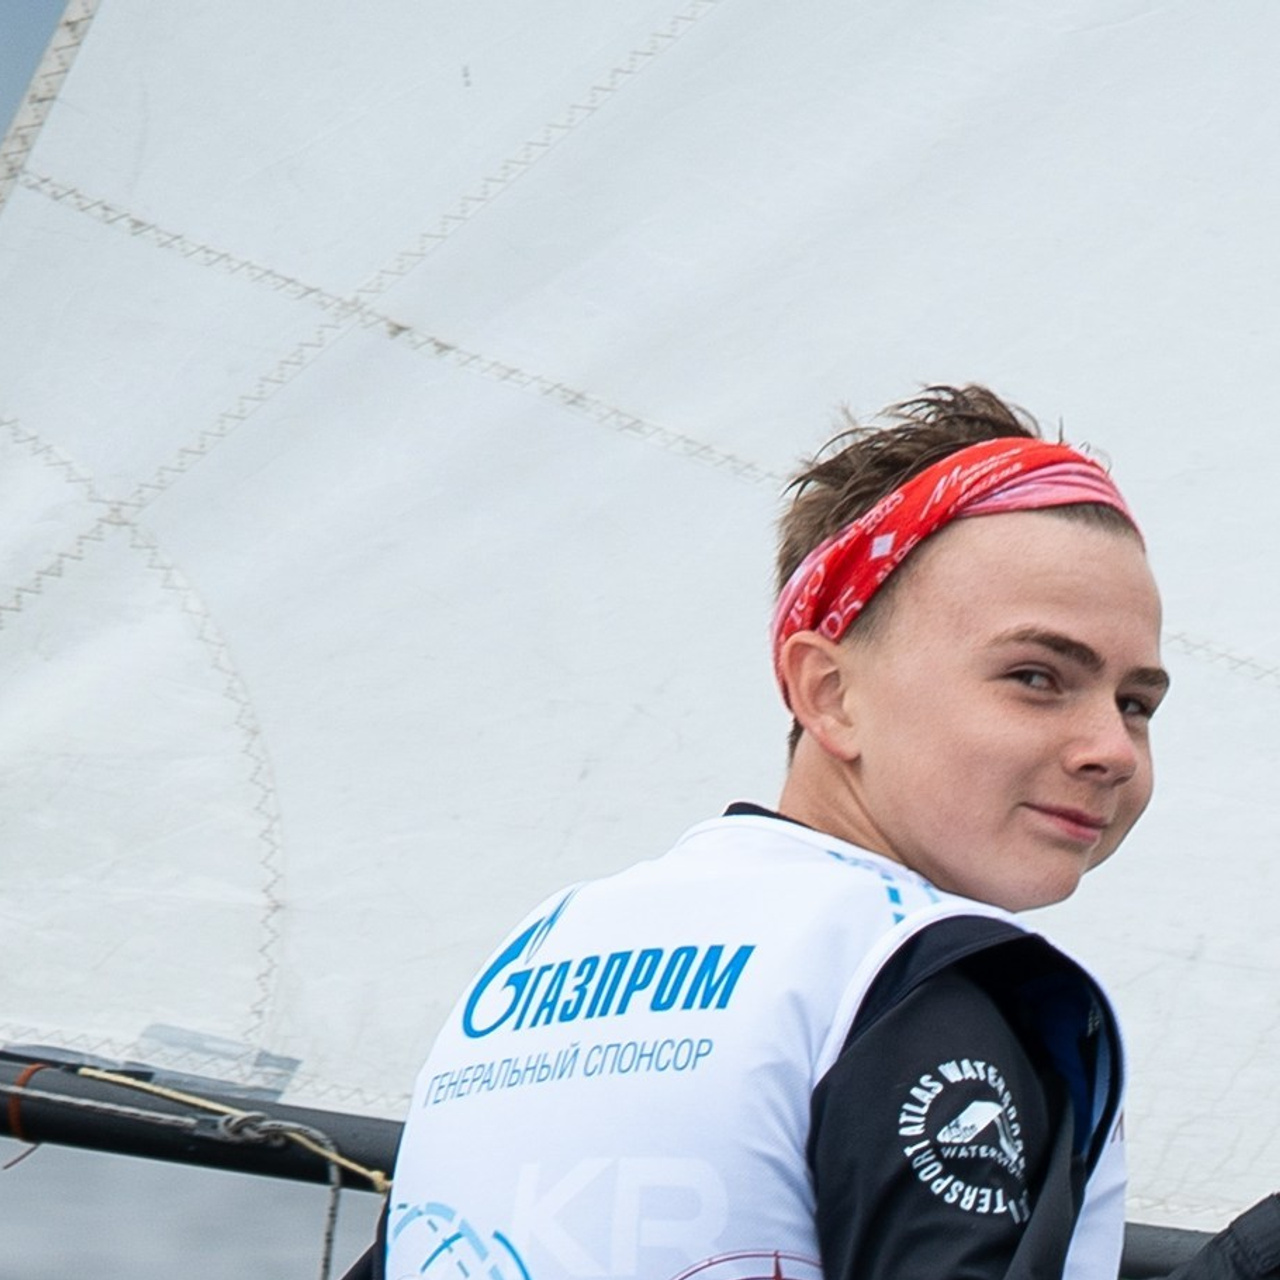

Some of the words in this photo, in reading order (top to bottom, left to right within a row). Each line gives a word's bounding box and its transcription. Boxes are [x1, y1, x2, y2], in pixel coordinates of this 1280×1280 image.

[512, 944, 757, 1032] ГАЗПРОМ
[423, 1043, 579, 1109] ГЕНЕРАЛЬНЫЙ
[583, 1037, 713, 1079] СПОНСОР
[898, 1074, 945, 1137] ATLAS
